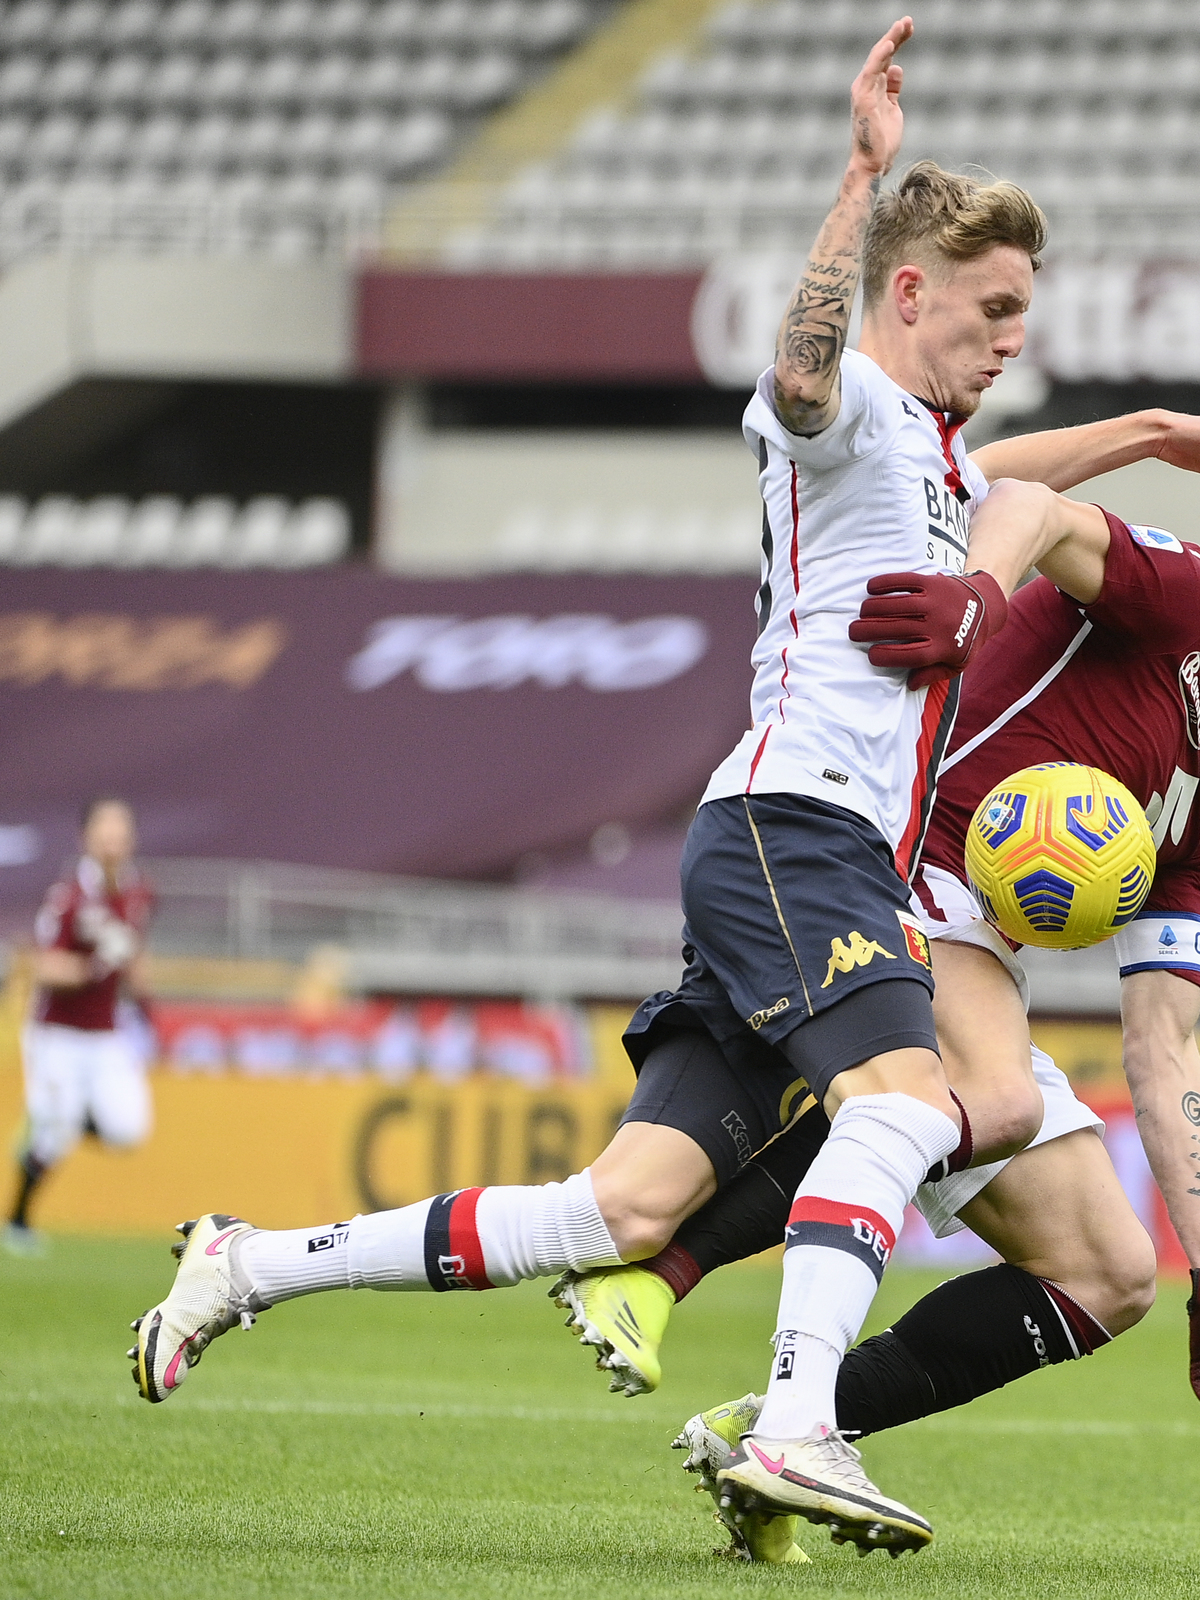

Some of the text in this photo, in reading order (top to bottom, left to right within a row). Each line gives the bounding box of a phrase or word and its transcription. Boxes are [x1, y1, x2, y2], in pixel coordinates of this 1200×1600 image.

[923, 475, 969, 543] BAN
[926, 541, 963, 575] SIS
[745, 996, 790, 1031] ppa
[352, 1087, 628, 1214] CUB
[437, 1254, 478, 1290] GE
